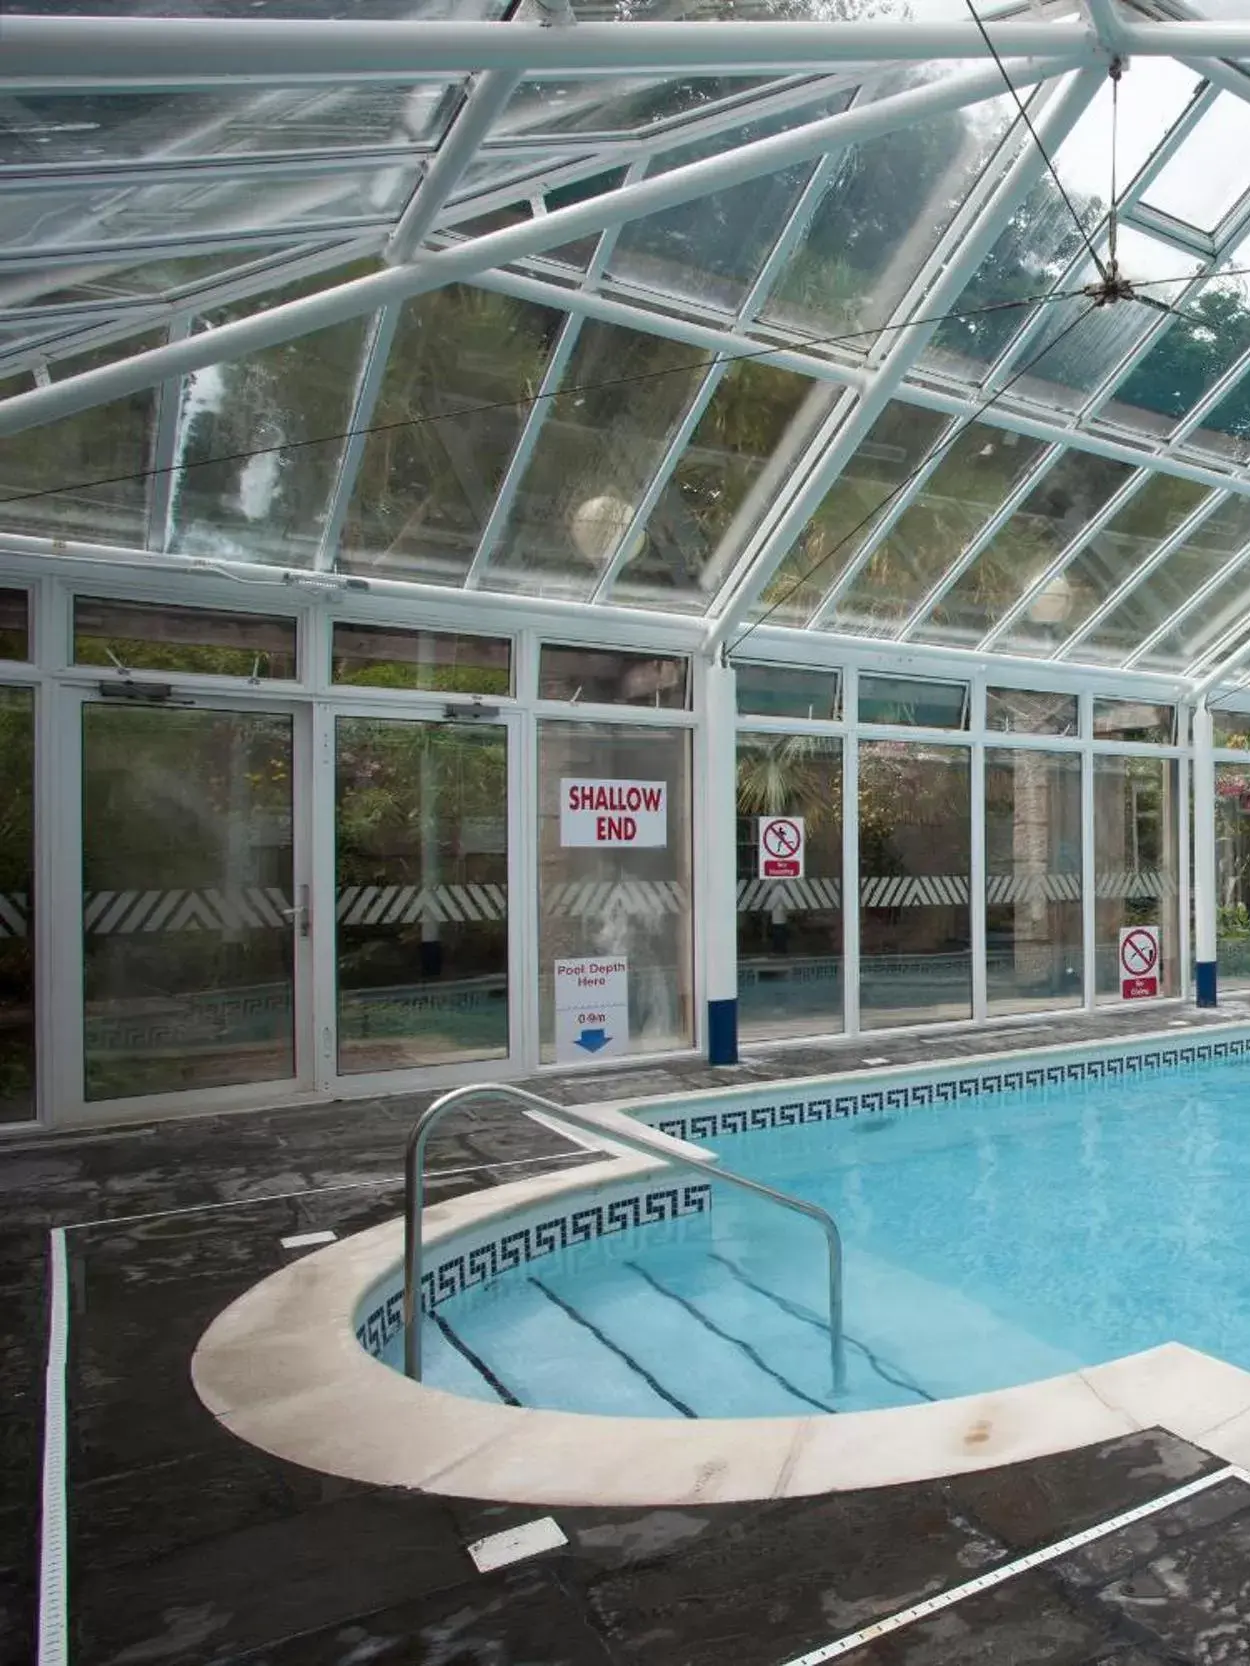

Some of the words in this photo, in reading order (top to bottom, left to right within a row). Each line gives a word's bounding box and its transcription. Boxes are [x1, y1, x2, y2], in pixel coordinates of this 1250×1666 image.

[569, 786, 662, 812] SHALLOW
[596, 816, 638, 841] END
[557, 964, 586, 976] Pool
[589, 962, 625, 975] Depth
[577, 977, 606, 987] Here
